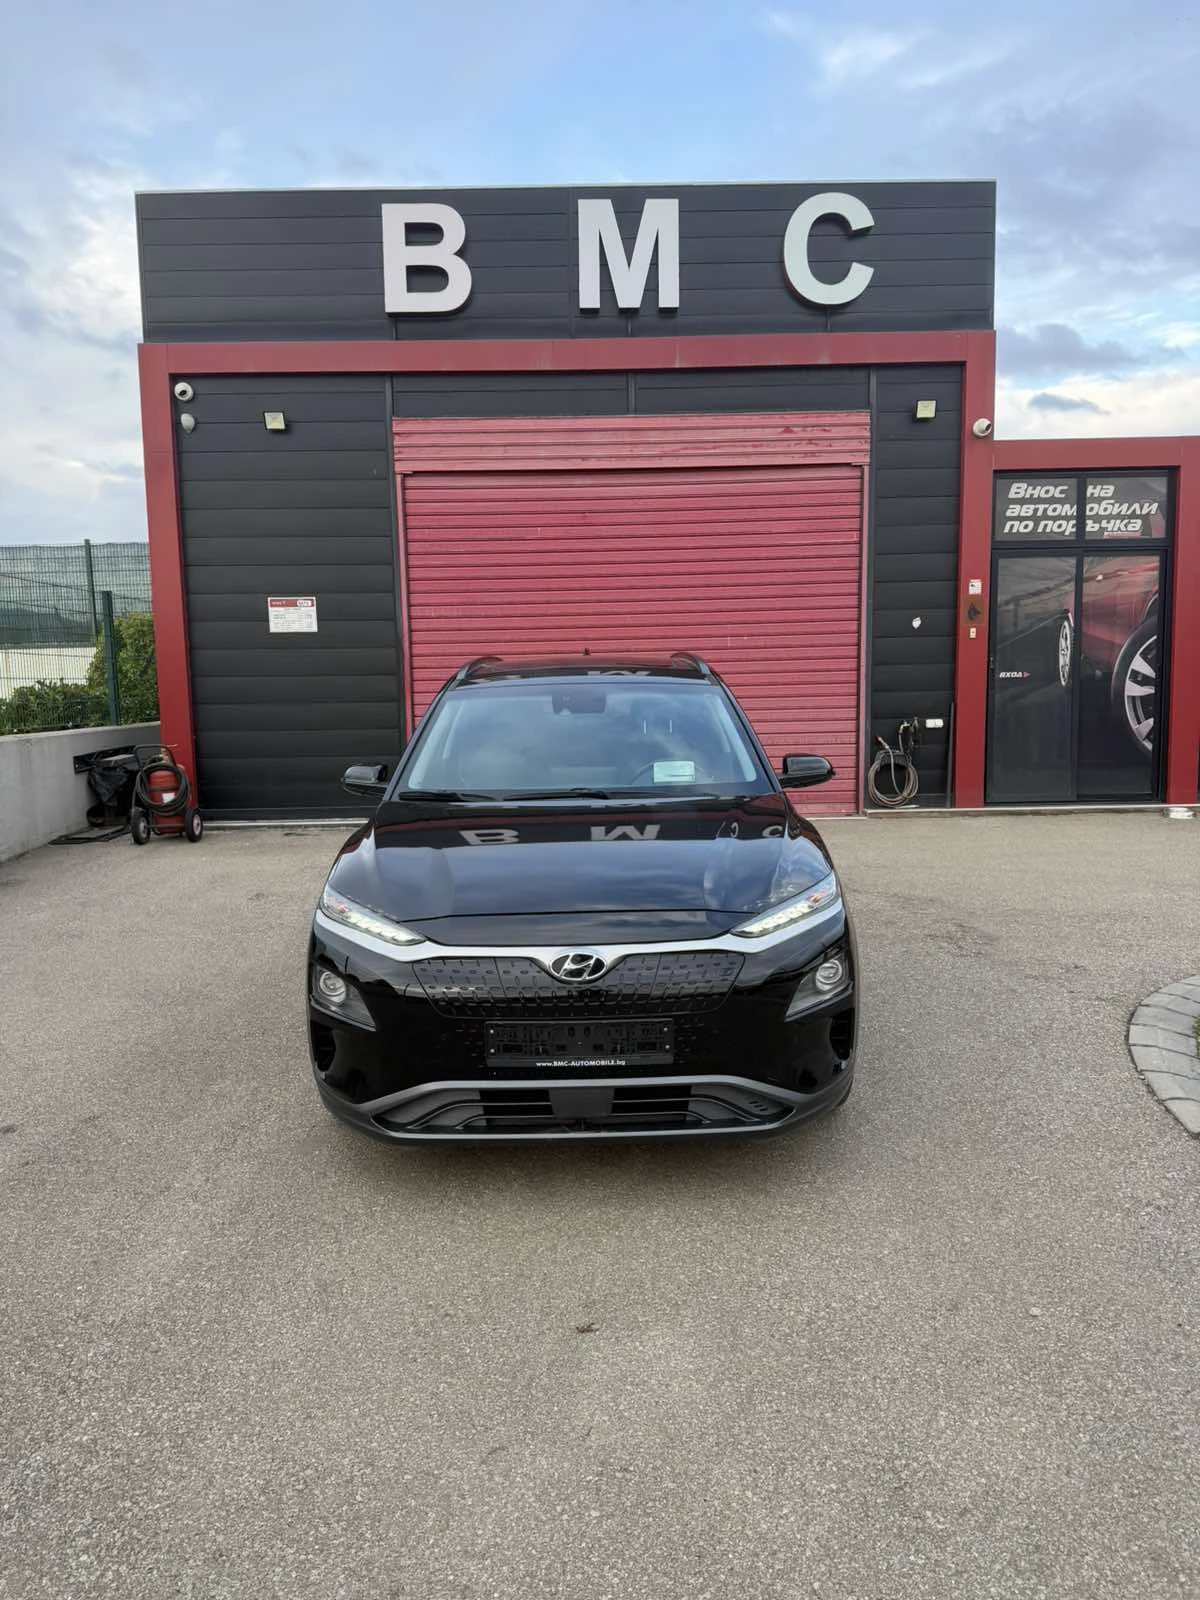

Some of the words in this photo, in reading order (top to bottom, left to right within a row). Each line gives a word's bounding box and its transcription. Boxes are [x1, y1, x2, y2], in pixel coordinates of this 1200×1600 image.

[381, 203, 473, 315] B
[577, 198, 680, 311] M
[783, 191, 876, 308] C
[1008, 482, 1069, 498] Внос
[1086, 484, 1115, 498] на
[1005, 499, 1159, 517] автомобили
[1003, 520, 1034, 533] по
